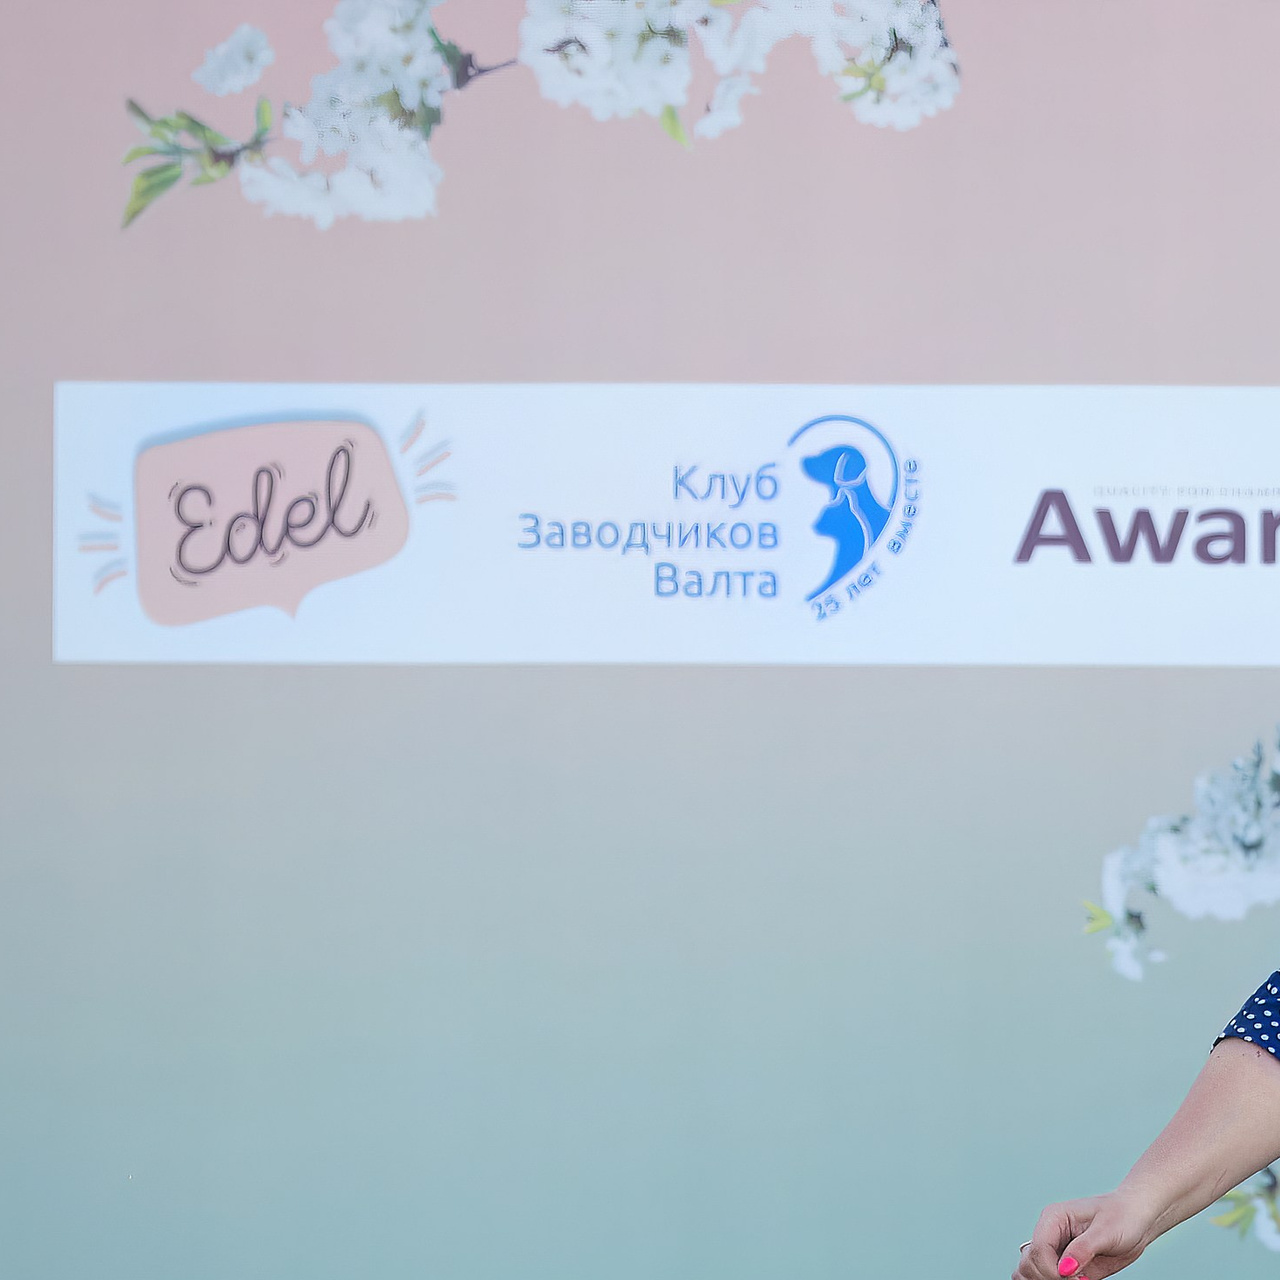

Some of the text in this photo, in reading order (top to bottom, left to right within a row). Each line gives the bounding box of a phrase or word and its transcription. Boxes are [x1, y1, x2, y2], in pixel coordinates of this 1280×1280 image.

[672, 462, 779, 508] Клуб
[174, 445, 371, 575] Edel
[517, 513, 779, 556] Заводчиков
[811, 459, 919, 620] 25 лет вместе
[653, 562, 779, 598] Валта
